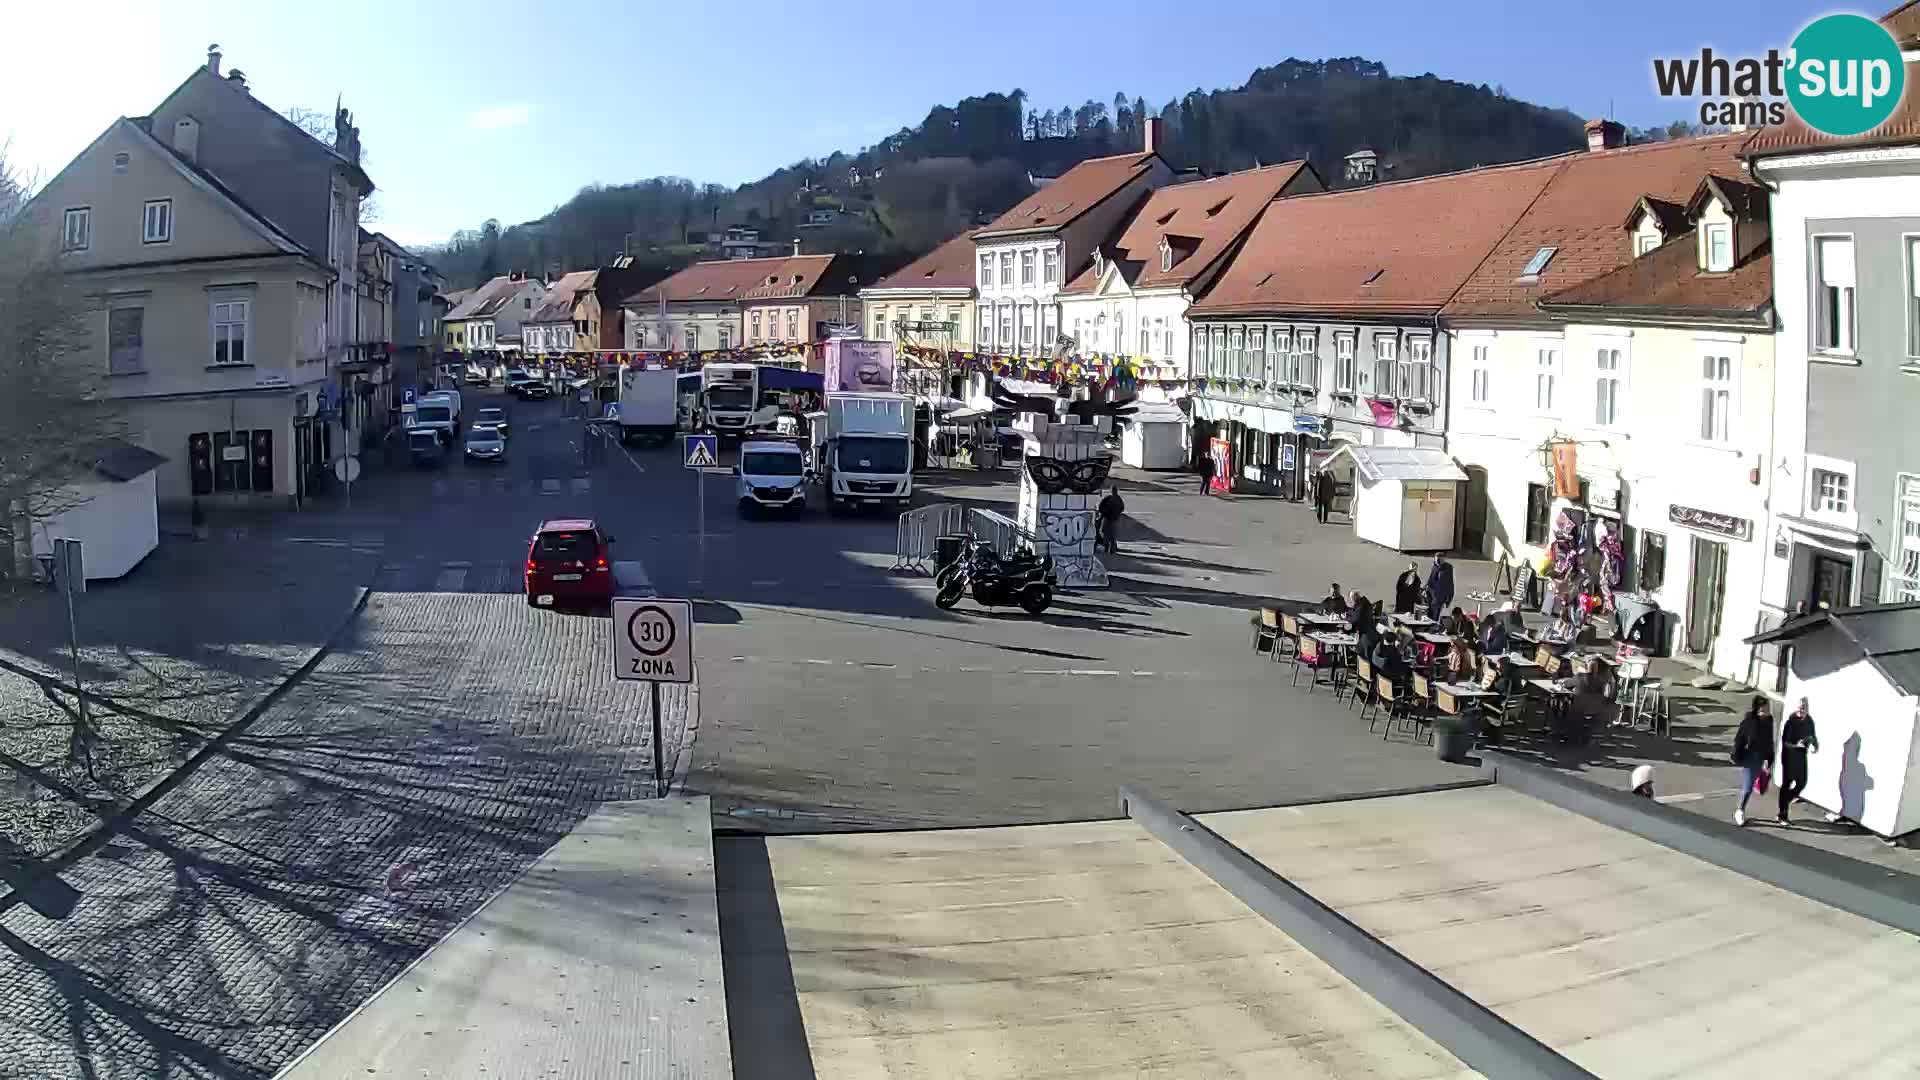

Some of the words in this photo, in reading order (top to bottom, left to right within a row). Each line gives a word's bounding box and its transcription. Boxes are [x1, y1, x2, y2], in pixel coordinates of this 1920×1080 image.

[405, 390, 413, 402] P
[640, 621, 665, 642] 30
[631, 658, 675, 676] ZONA
